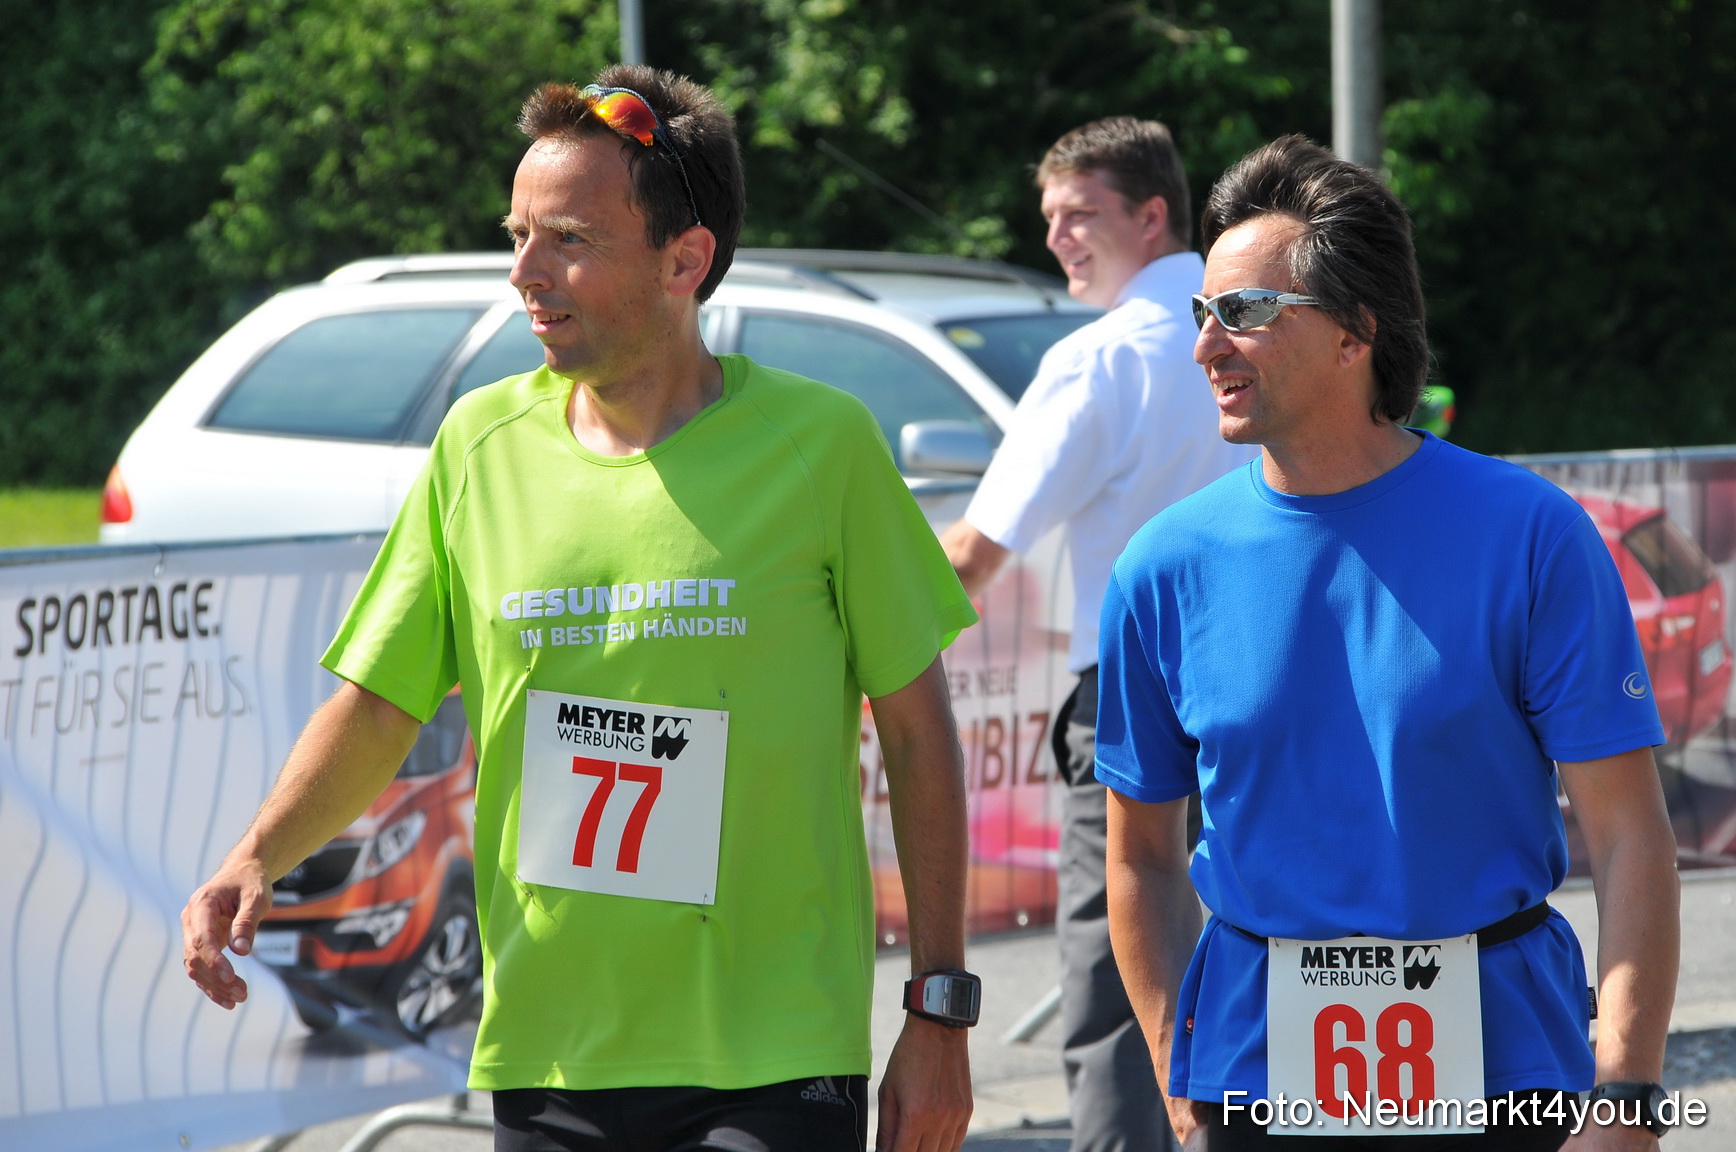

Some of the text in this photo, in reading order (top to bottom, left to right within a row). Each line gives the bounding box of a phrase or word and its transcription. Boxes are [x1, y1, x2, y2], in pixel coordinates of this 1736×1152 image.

[14, 580, 221, 657] SPORTAGE.
[500, 579, 736, 620] GESUNDHEIT
[520, 613, 747, 649] IN BESTEN HÄNDEN
[30, 659, 102, 737] FÜR
[557, 702, 646, 736] MEYER
[557, 726, 645, 752] WERBUNG
[969, 710, 1062, 791] IBIZ
[572, 756, 663, 874] 77
[1300, 946, 1396, 969] MEYER
[1300, 970, 1397, 986] WERBUNG
[1313, 1002, 1436, 1119] 68
[801, 1088, 846, 1107] adidas
